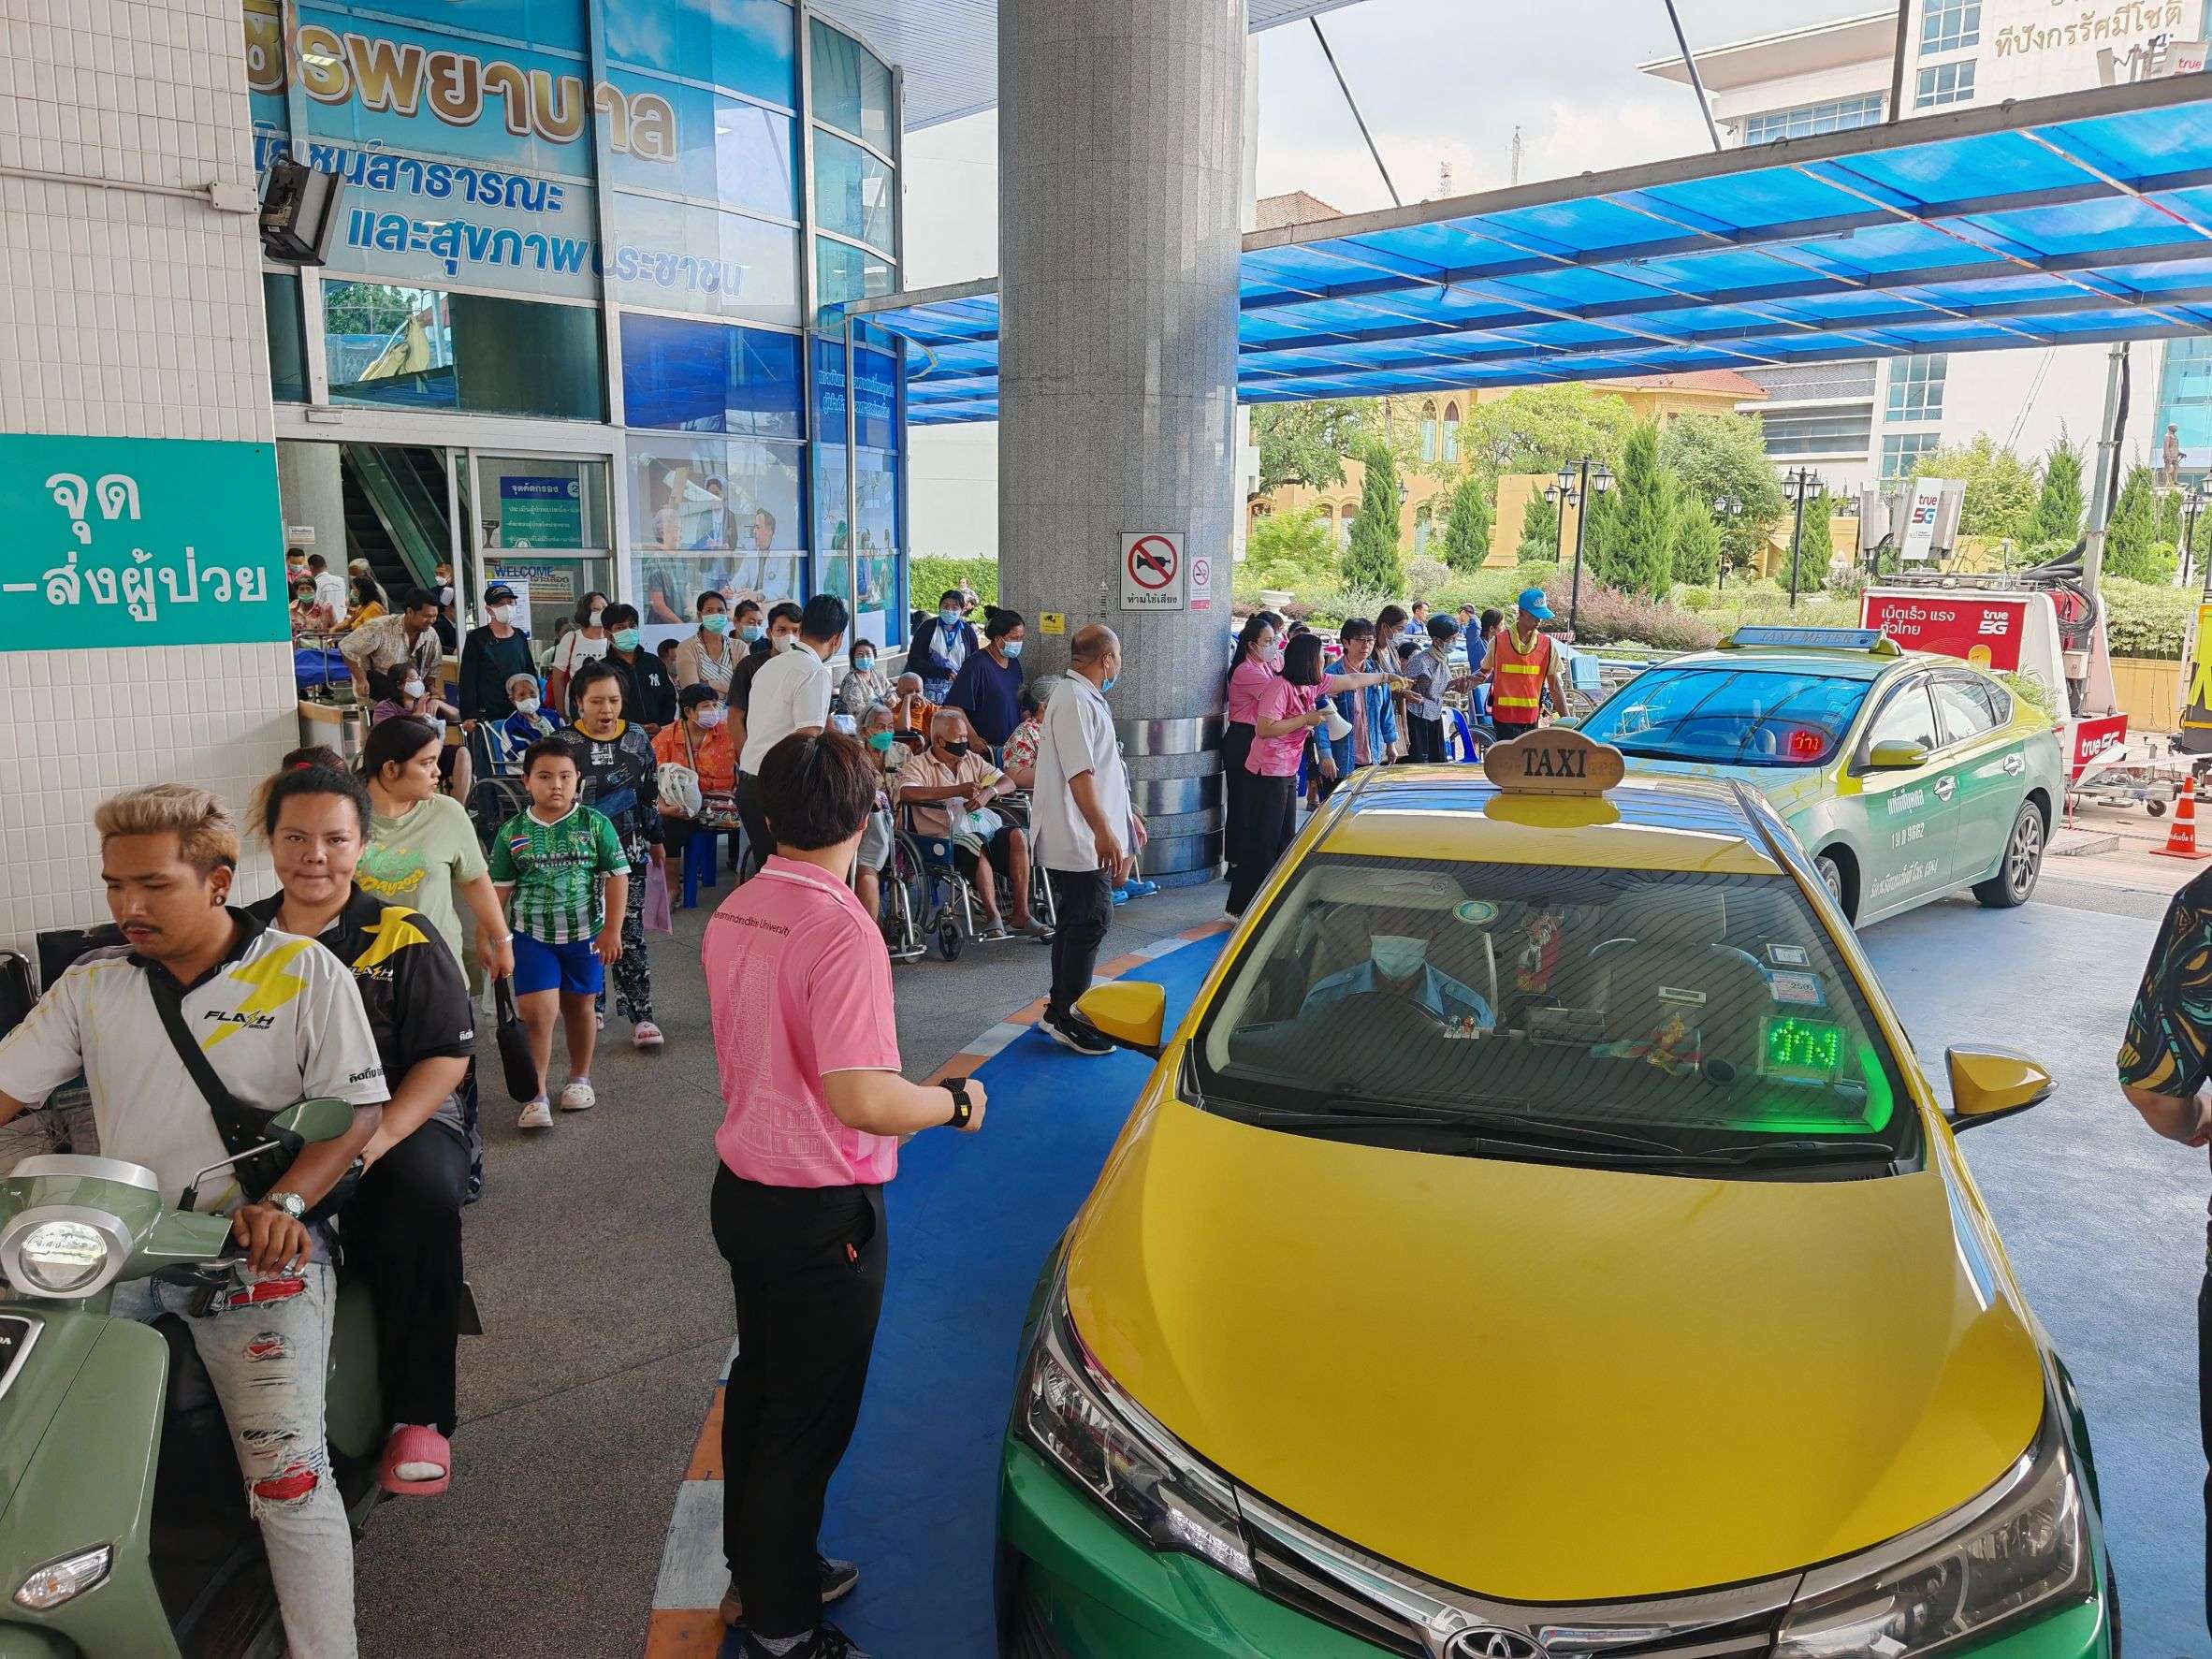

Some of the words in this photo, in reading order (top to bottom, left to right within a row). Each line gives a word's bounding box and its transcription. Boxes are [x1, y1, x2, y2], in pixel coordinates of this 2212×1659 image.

[1919, 494, 1938, 506] true
[45, 473, 141, 545] จุด
[1912, 508, 1936, 525] 5G
[494, 564, 555, 578] WELCOME
[1127, 592, 1178, 604] ห้ามใช้เสียง
[1882, 604, 1927, 621] เน็ตเร็ว
[1930, 611, 1956, 622] แรง
[1983, 610, 2010, 620] true
[1881, 618, 1921, 635] ทั่วไทย
[1977, 620, 2010, 635] 5G
[1521, 748, 1588, 779] TAXI
